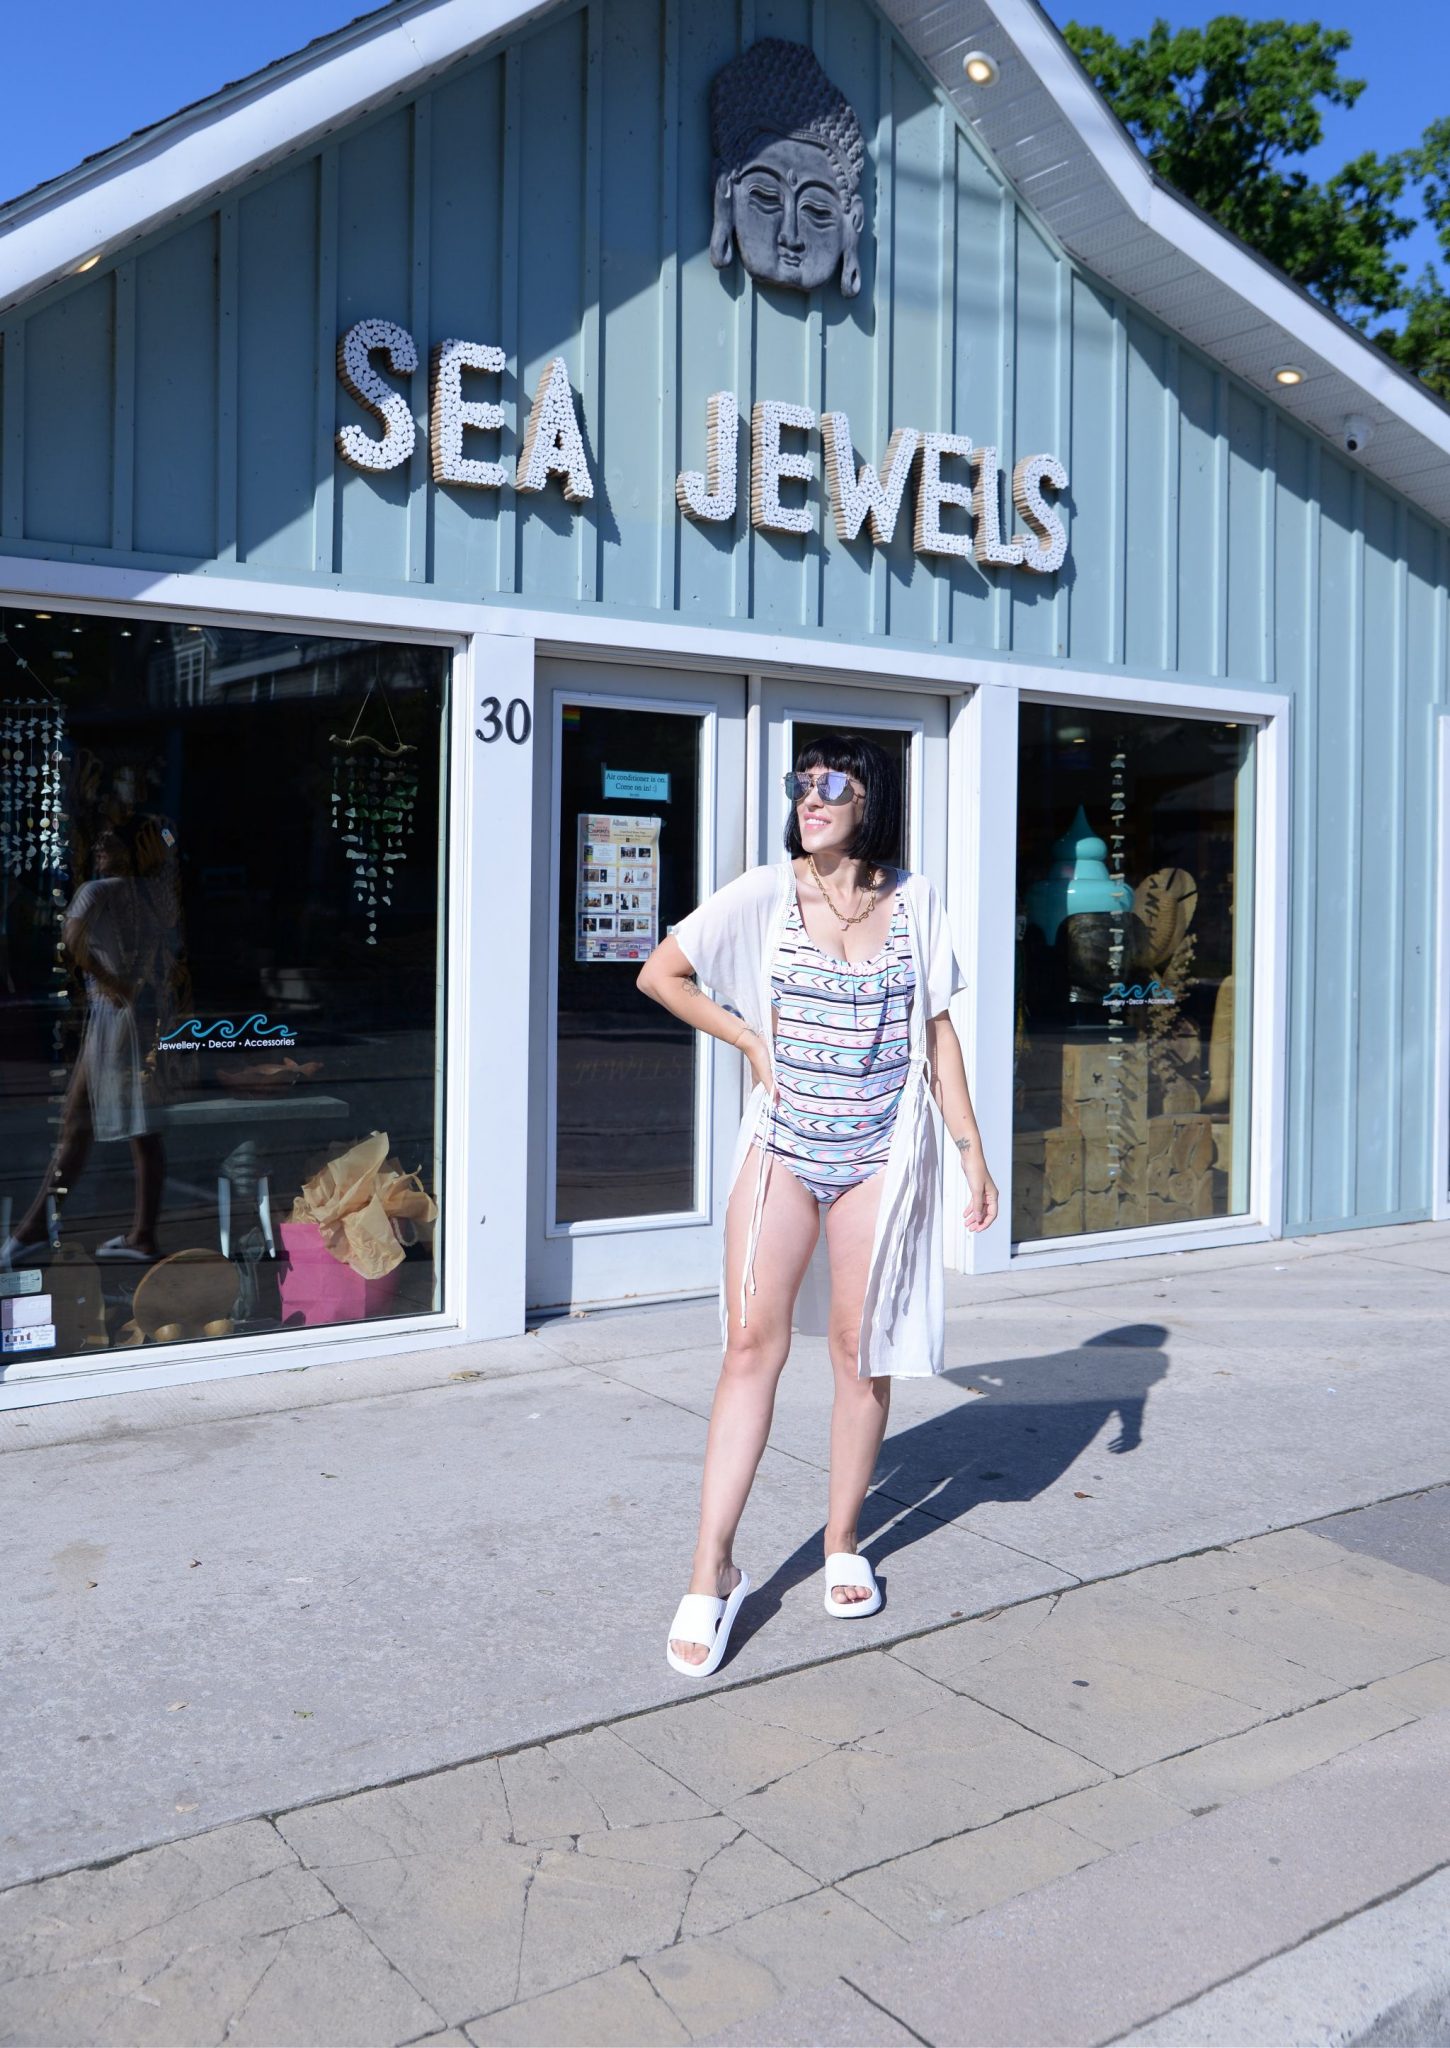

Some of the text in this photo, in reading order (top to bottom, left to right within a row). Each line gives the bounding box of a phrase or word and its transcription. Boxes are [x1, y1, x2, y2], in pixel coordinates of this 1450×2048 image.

[336, 318, 1070, 574] SEA JEWELS
[475, 696, 532, 745] 30
[158, 1037, 296, 1051] Jewellery Decor Accessories
